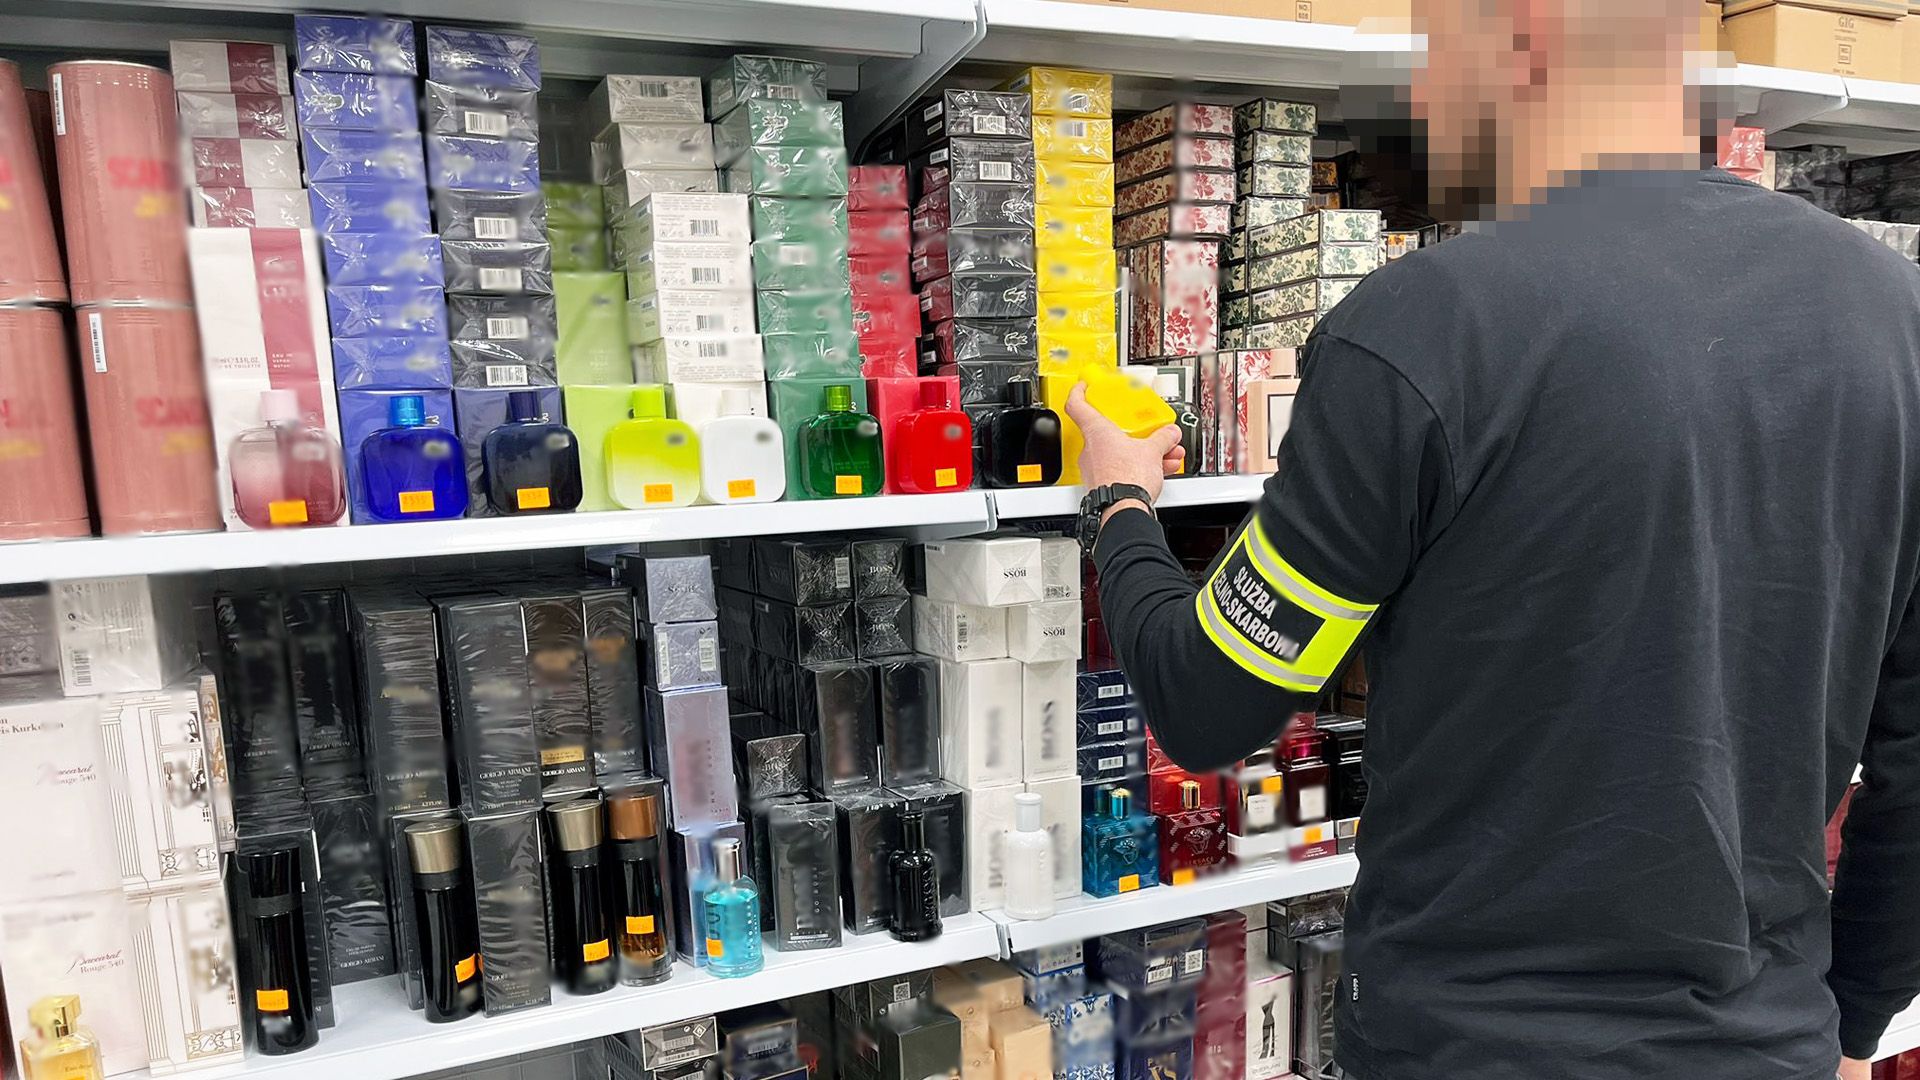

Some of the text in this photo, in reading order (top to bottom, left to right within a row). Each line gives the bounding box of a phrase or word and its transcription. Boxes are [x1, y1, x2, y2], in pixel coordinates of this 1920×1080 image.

[1003, 569, 1027, 579] BOSS
[1233, 565, 1278, 620] SŁUŻBA
[1043, 627, 1066, 637] BOSS
[507, 767, 531, 776] ARMANI
[542, 766, 587, 777] GIORGIO ARMANI
